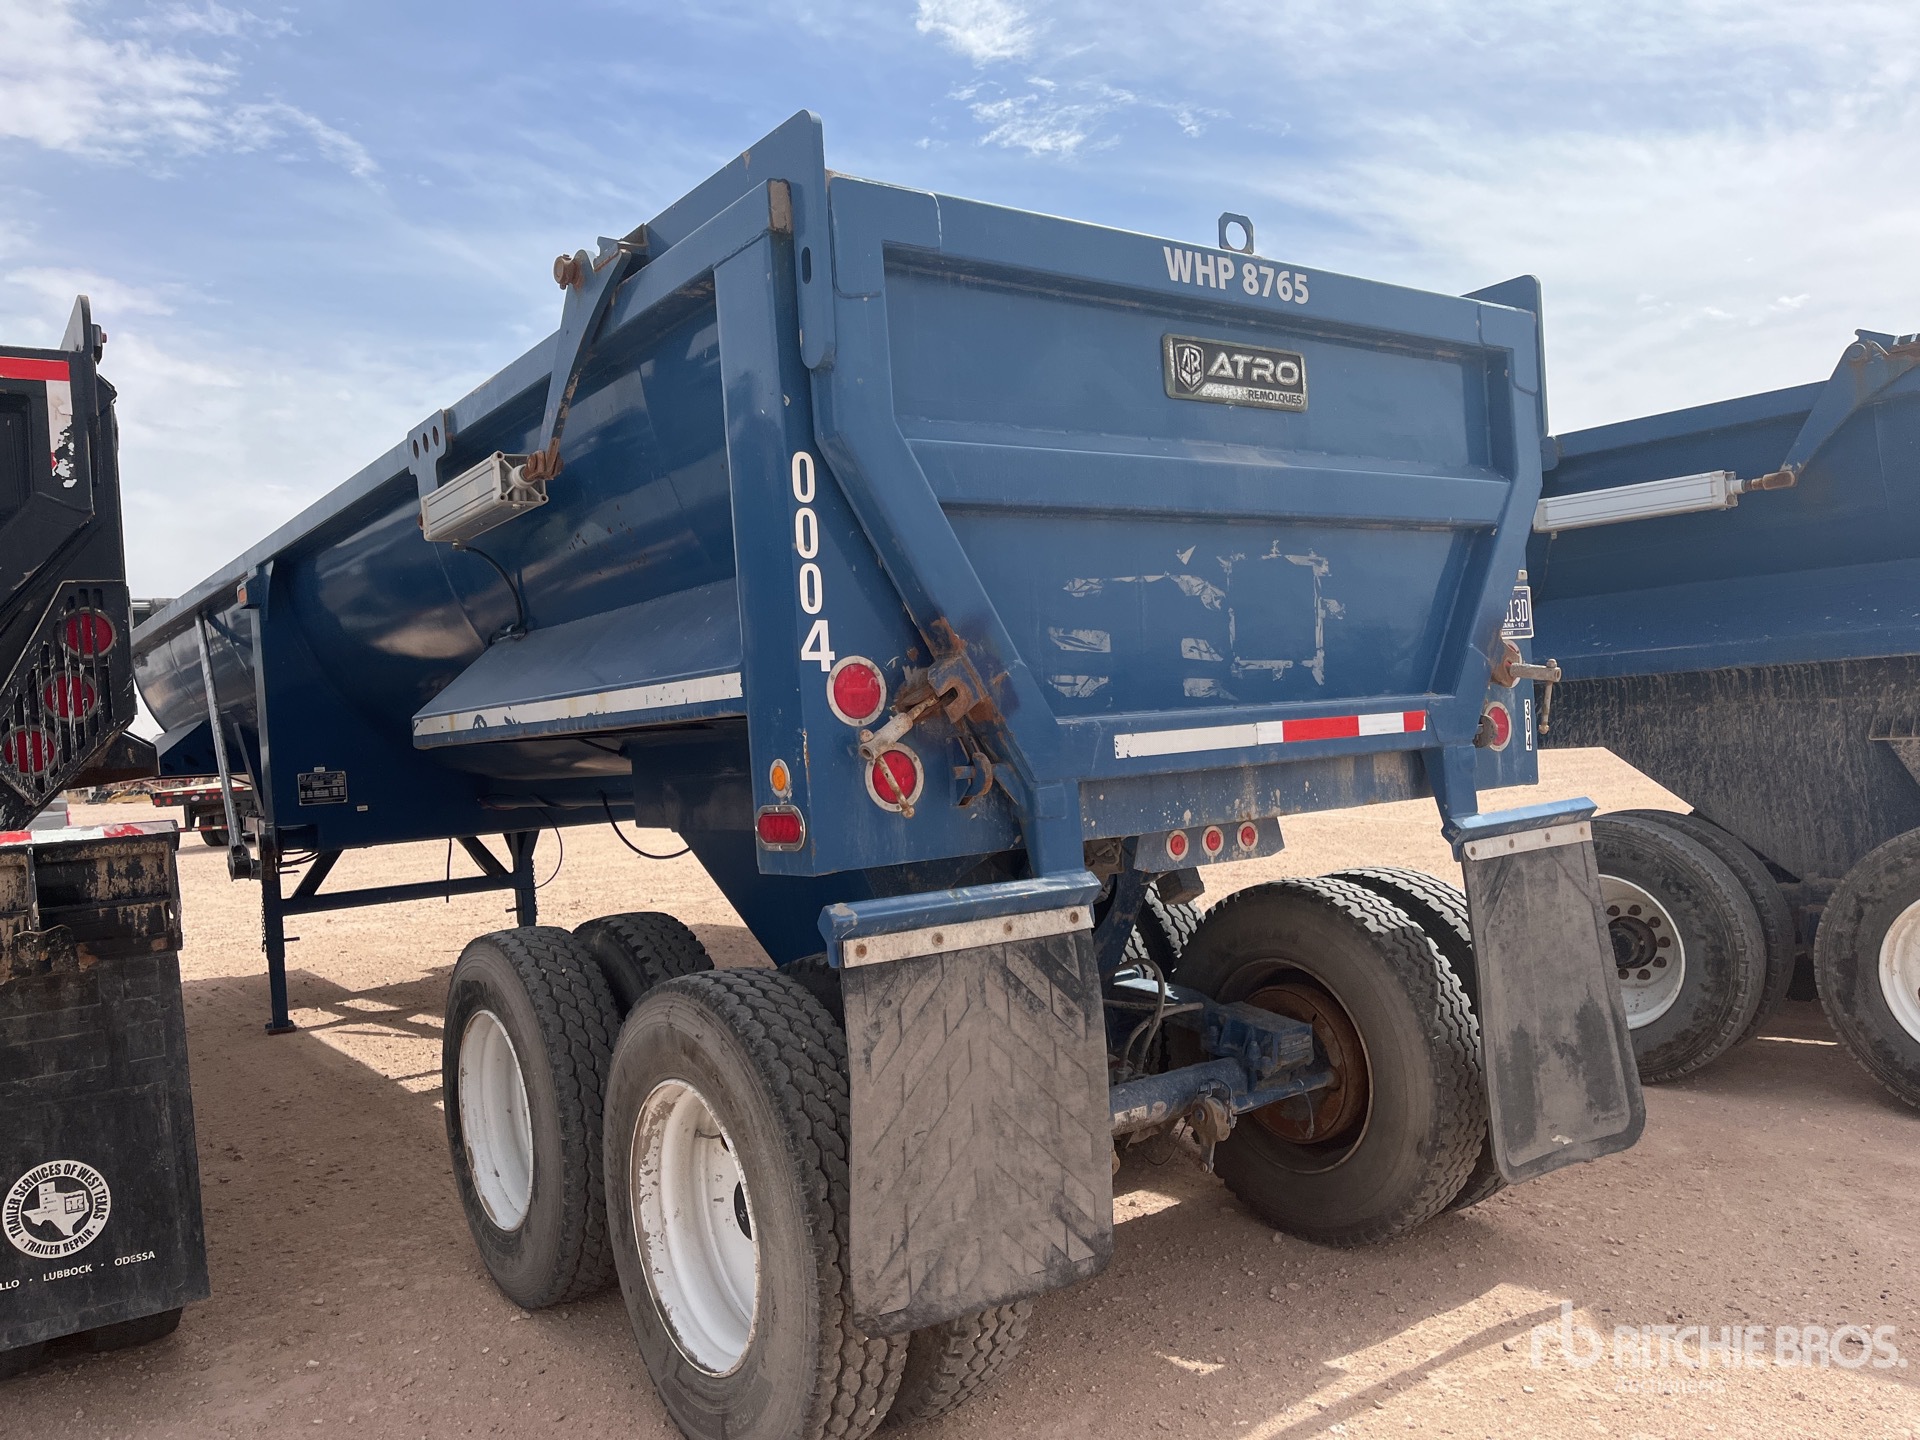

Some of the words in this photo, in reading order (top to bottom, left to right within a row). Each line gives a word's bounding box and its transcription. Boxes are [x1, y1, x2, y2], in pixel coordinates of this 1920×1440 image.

[1163, 246, 1235, 290] WHP
[1242, 263, 1309, 304] 8765
[1206, 352, 1299, 386] ATRO
[1248, 389, 1303, 404] REMOLQUES
[791, 451, 835, 672] 0004
[13, 1163, 62, 1197] SERVICES
[63, 1163, 78, 1176] OF
[76, 1166, 103, 1191] WEST
[6, 1197, 23, 1239] TRAILER
[93, 1189, 108, 1220] TEXAS
[24, 1239, 60, 1255] TRAILER
[62, 1228, 94, 1252] REPAIR
[43, 1264, 93, 1282] LUBBOCK
[114, 1250, 156, 1266] ODESSA
